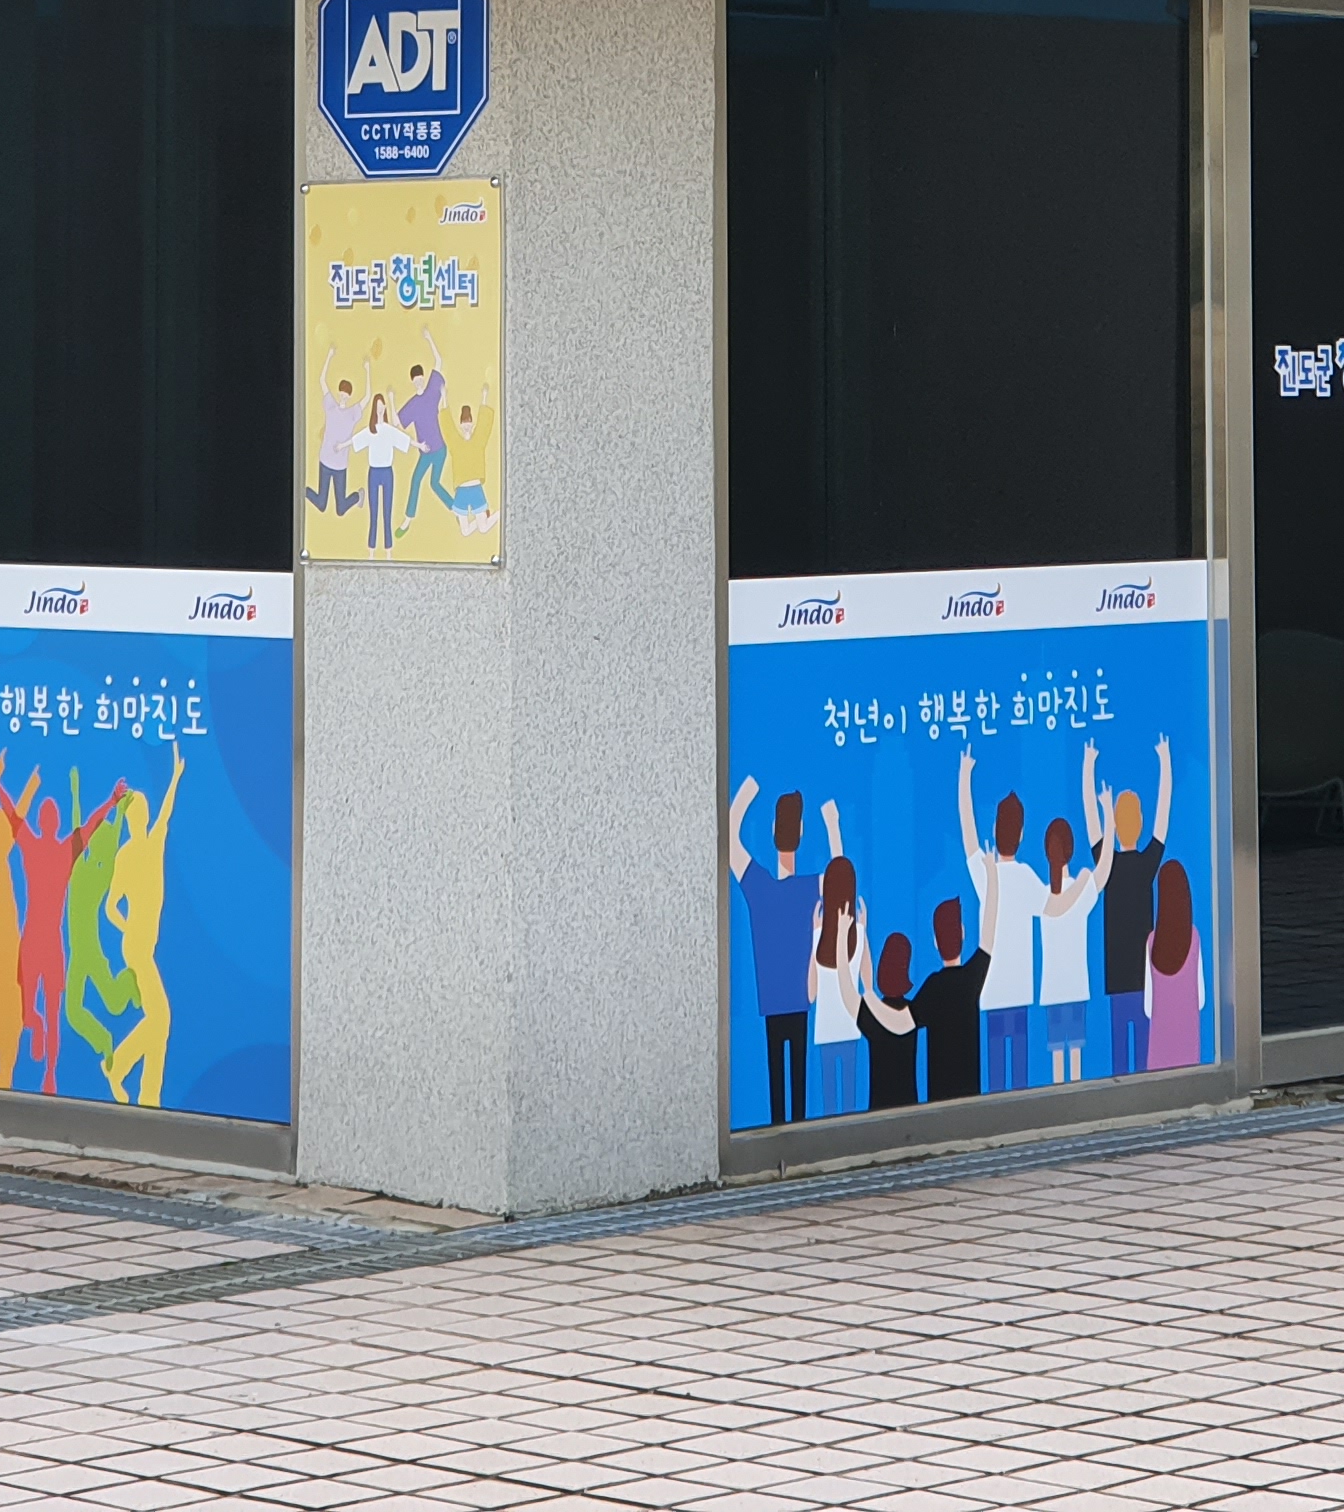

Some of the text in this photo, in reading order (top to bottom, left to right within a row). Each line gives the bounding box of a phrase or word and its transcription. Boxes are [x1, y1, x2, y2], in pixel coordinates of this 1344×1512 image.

[347, 9, 460, 94] ADT
[361, 121, 442, 141] CCTV작동중
[374, 145, 430, 160] 1588-6400
[440, 206, 478, 224] Jindo
[329, 253, 479, 308] 진도군 청년센터
[1274, 344, 1333, 396] 진도군
[23, 589, 78, 614] Jindo
[188, 594, 245, 621] Jindo
[941, 595, 994, 620] Jindo
[1095, 588, 1145, 613] Jindo
[777, 603, 834, 628] Jindo
[0, 684, 84, 736] 행복한
[93, 682, 209, 741] 희망진도
[823, 675, 1115, 747] 청년이 행복한 희망진도
